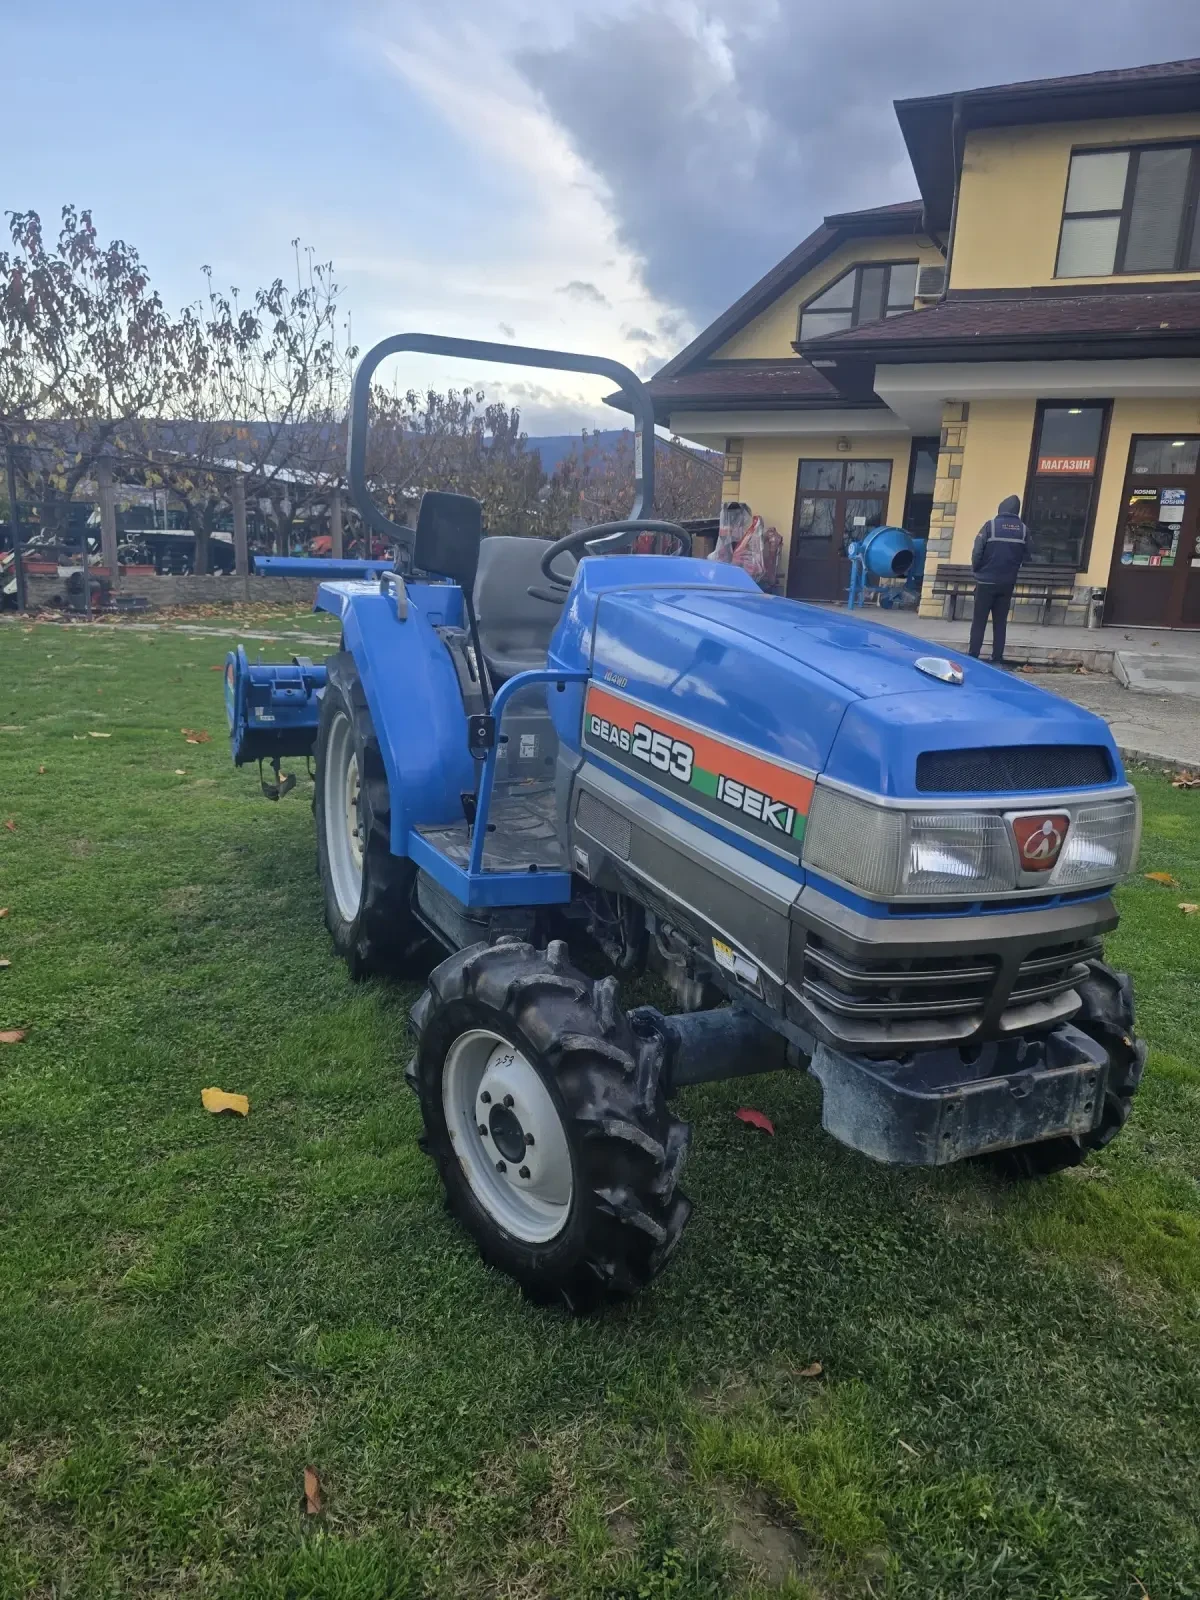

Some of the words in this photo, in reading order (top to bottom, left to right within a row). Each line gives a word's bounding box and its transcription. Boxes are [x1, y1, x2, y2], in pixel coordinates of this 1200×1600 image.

[1041, 459, 1091, 470] МАГАЗИН
[591, 715, 630, 752] GEAS
[632, 723, 694, 784] 253
[717, 774, 797, 836] ISEKI
[495, 1055, 515, 1067] 253
